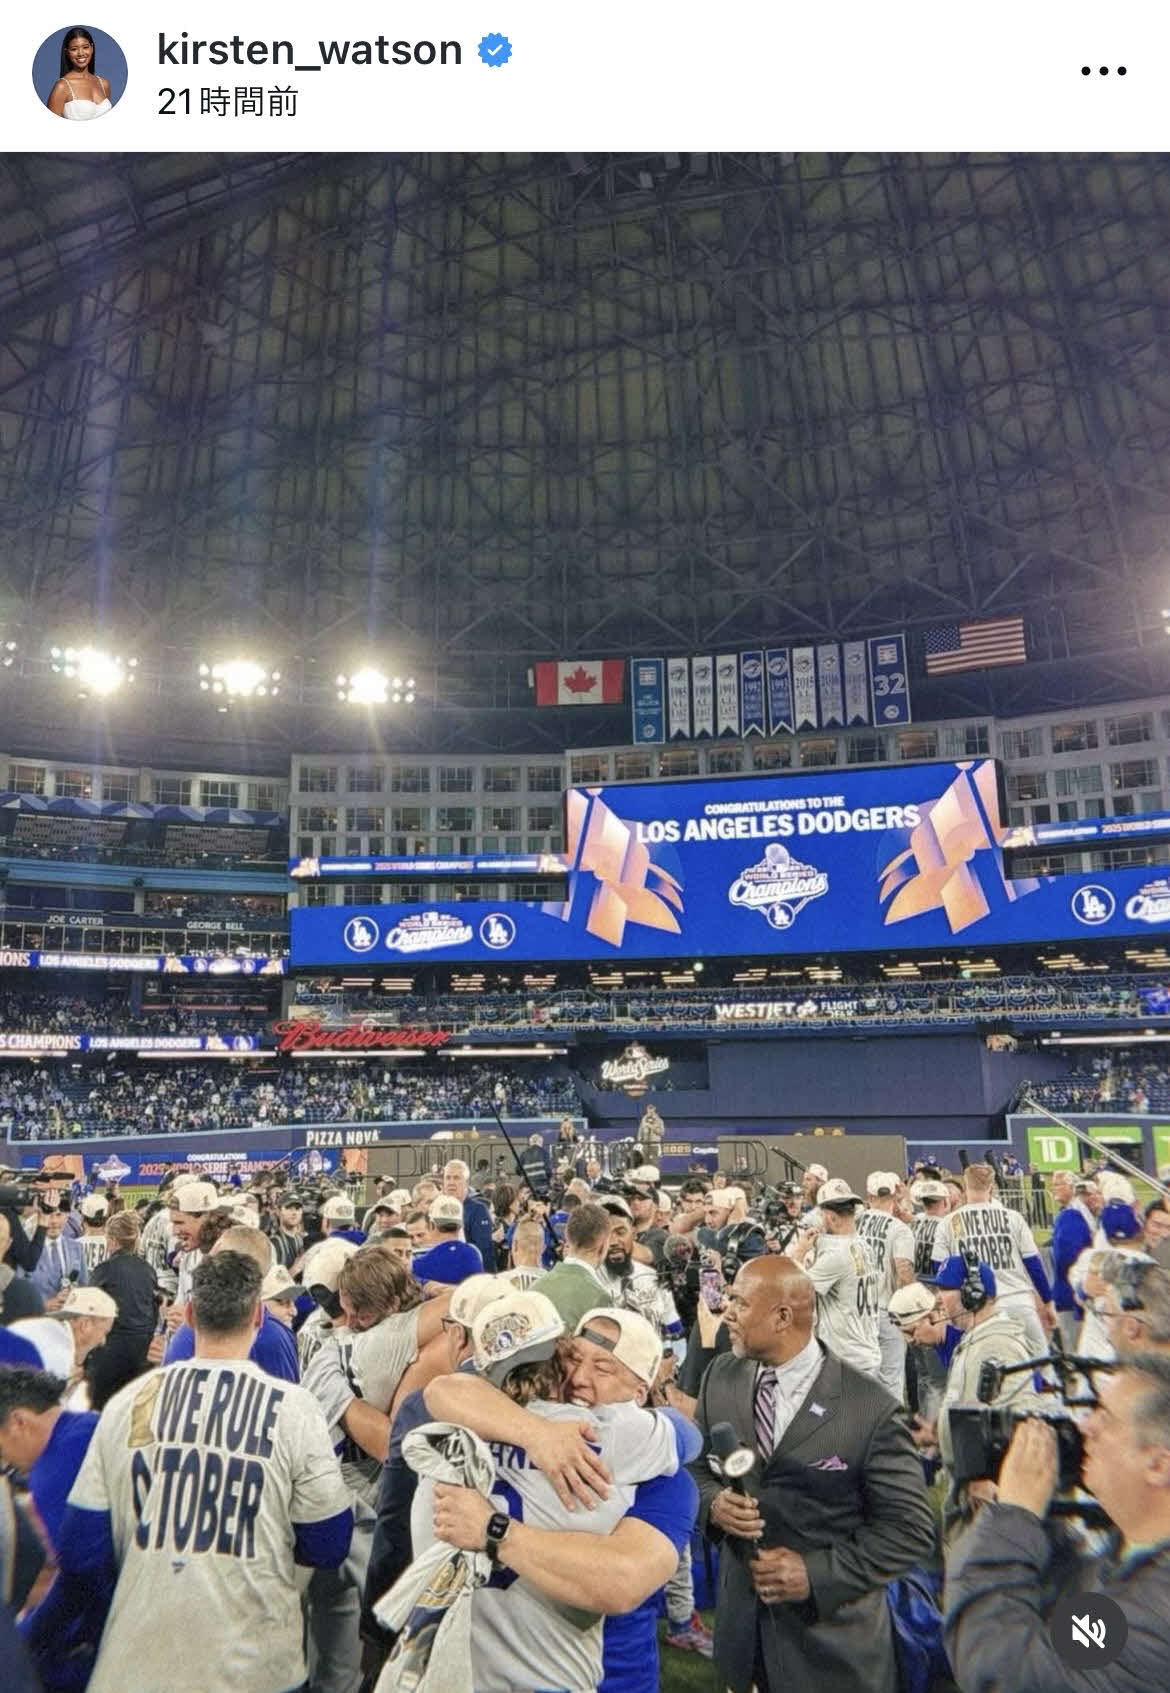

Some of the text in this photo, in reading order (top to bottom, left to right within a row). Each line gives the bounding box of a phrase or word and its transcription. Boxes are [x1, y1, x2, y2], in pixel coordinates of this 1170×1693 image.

[873, 673, 905, 696] 32
[704, 795, 845, 815] CONGRATULATIONS TO THE
[636, 805, 921, 843] LOS ANGELES DODGERS
[731, 873, 826, 905] Champions
[48, 914, 104, 926] JOE CARTER
[187, 920, 245, 931] GEORGE BELL
[386, 925, 474, 952] Champions
[62, 955, 108, 970] ANGELES
[821, 1000, 858, 1011] FLIGHT
[8, 1035, 82, 1050] CHAMPIONS
[90, 1037, 108, 1049] LOS
[109, 1037, 153, 1049] ANGELES
[155, 1037, 201, 1049] DODGERS
[273, 1020, 450, 1050] Budweiser
[306, 1129, 379, 1147] PIZZA NOVA
[1033, 1135, 1073, 1162] TD
[961, 1209, 1011, 1236] WE RULE
[157, 1367, 286, 1460] WE RULE
